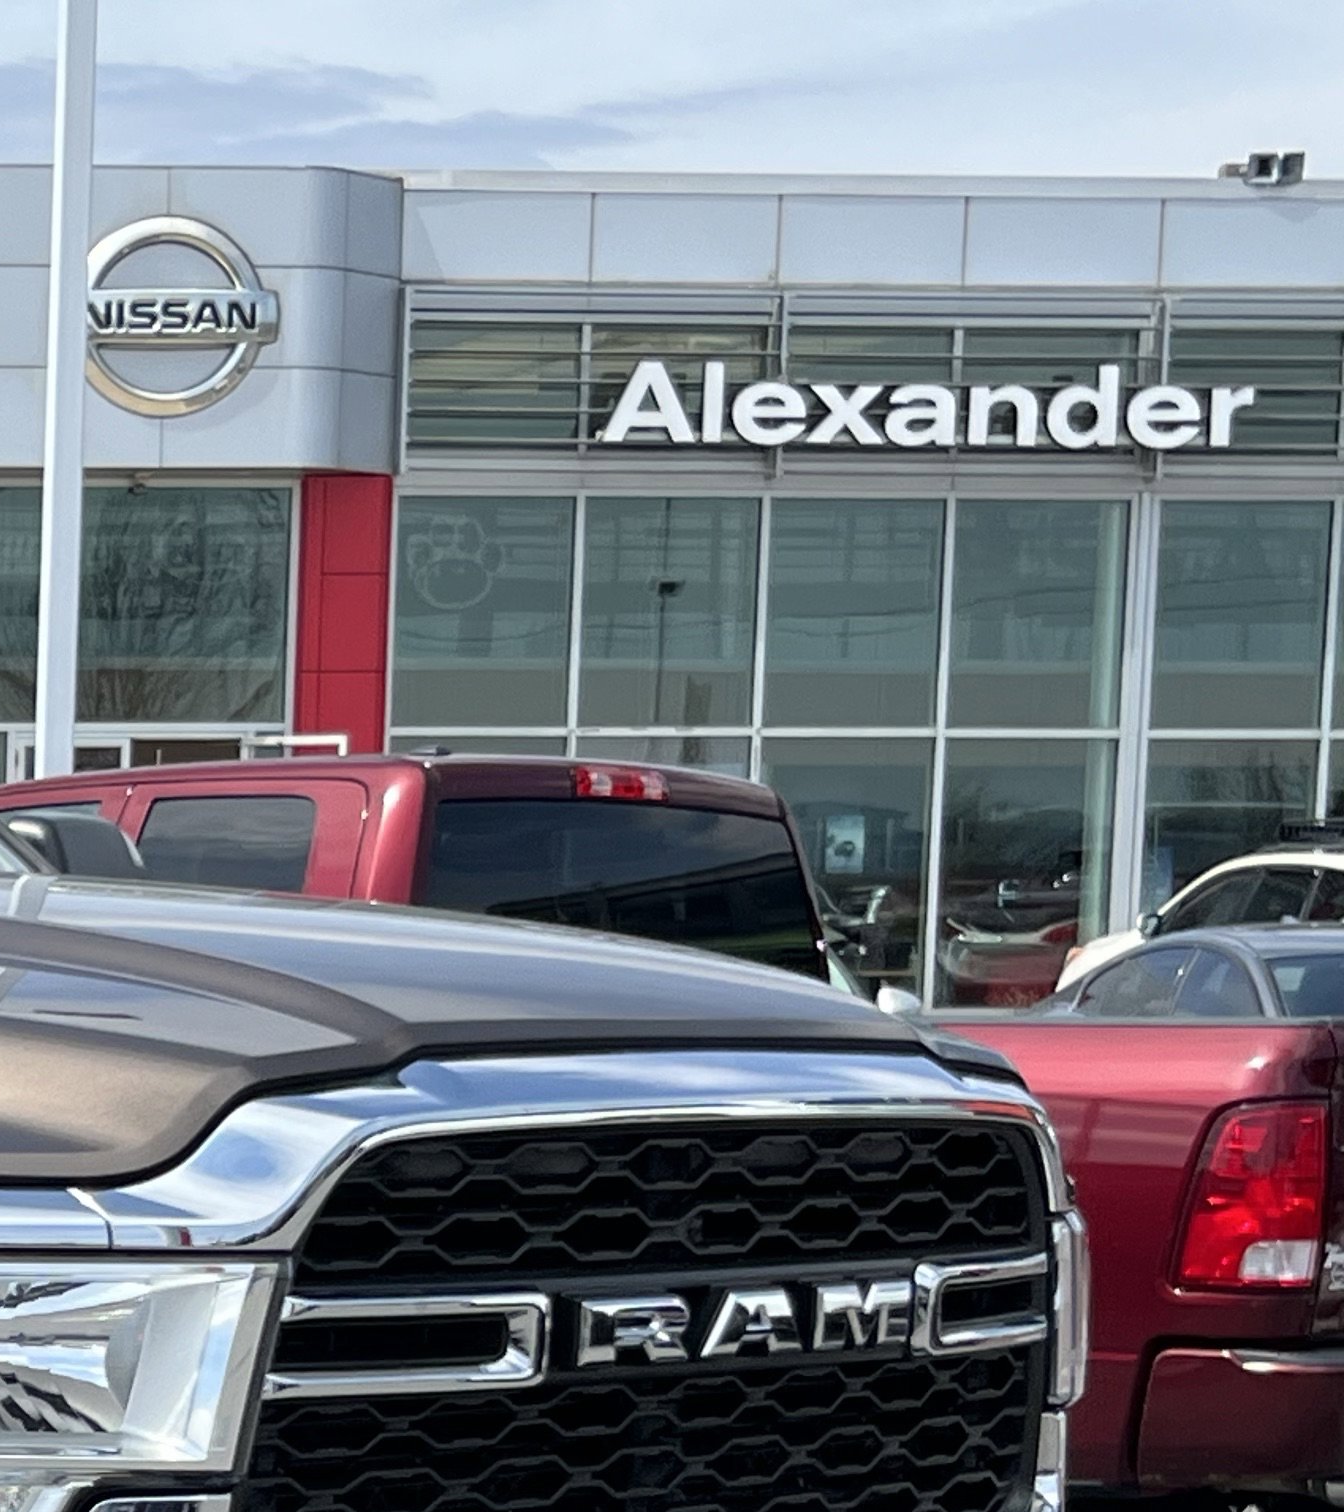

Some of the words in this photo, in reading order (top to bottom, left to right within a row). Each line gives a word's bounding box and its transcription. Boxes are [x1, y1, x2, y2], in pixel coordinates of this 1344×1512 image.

[88, 299, 258, 331] NISSAN
[600, 359, 1256, 450] Alexander
[578, 1282, 913, 1367] RAM
